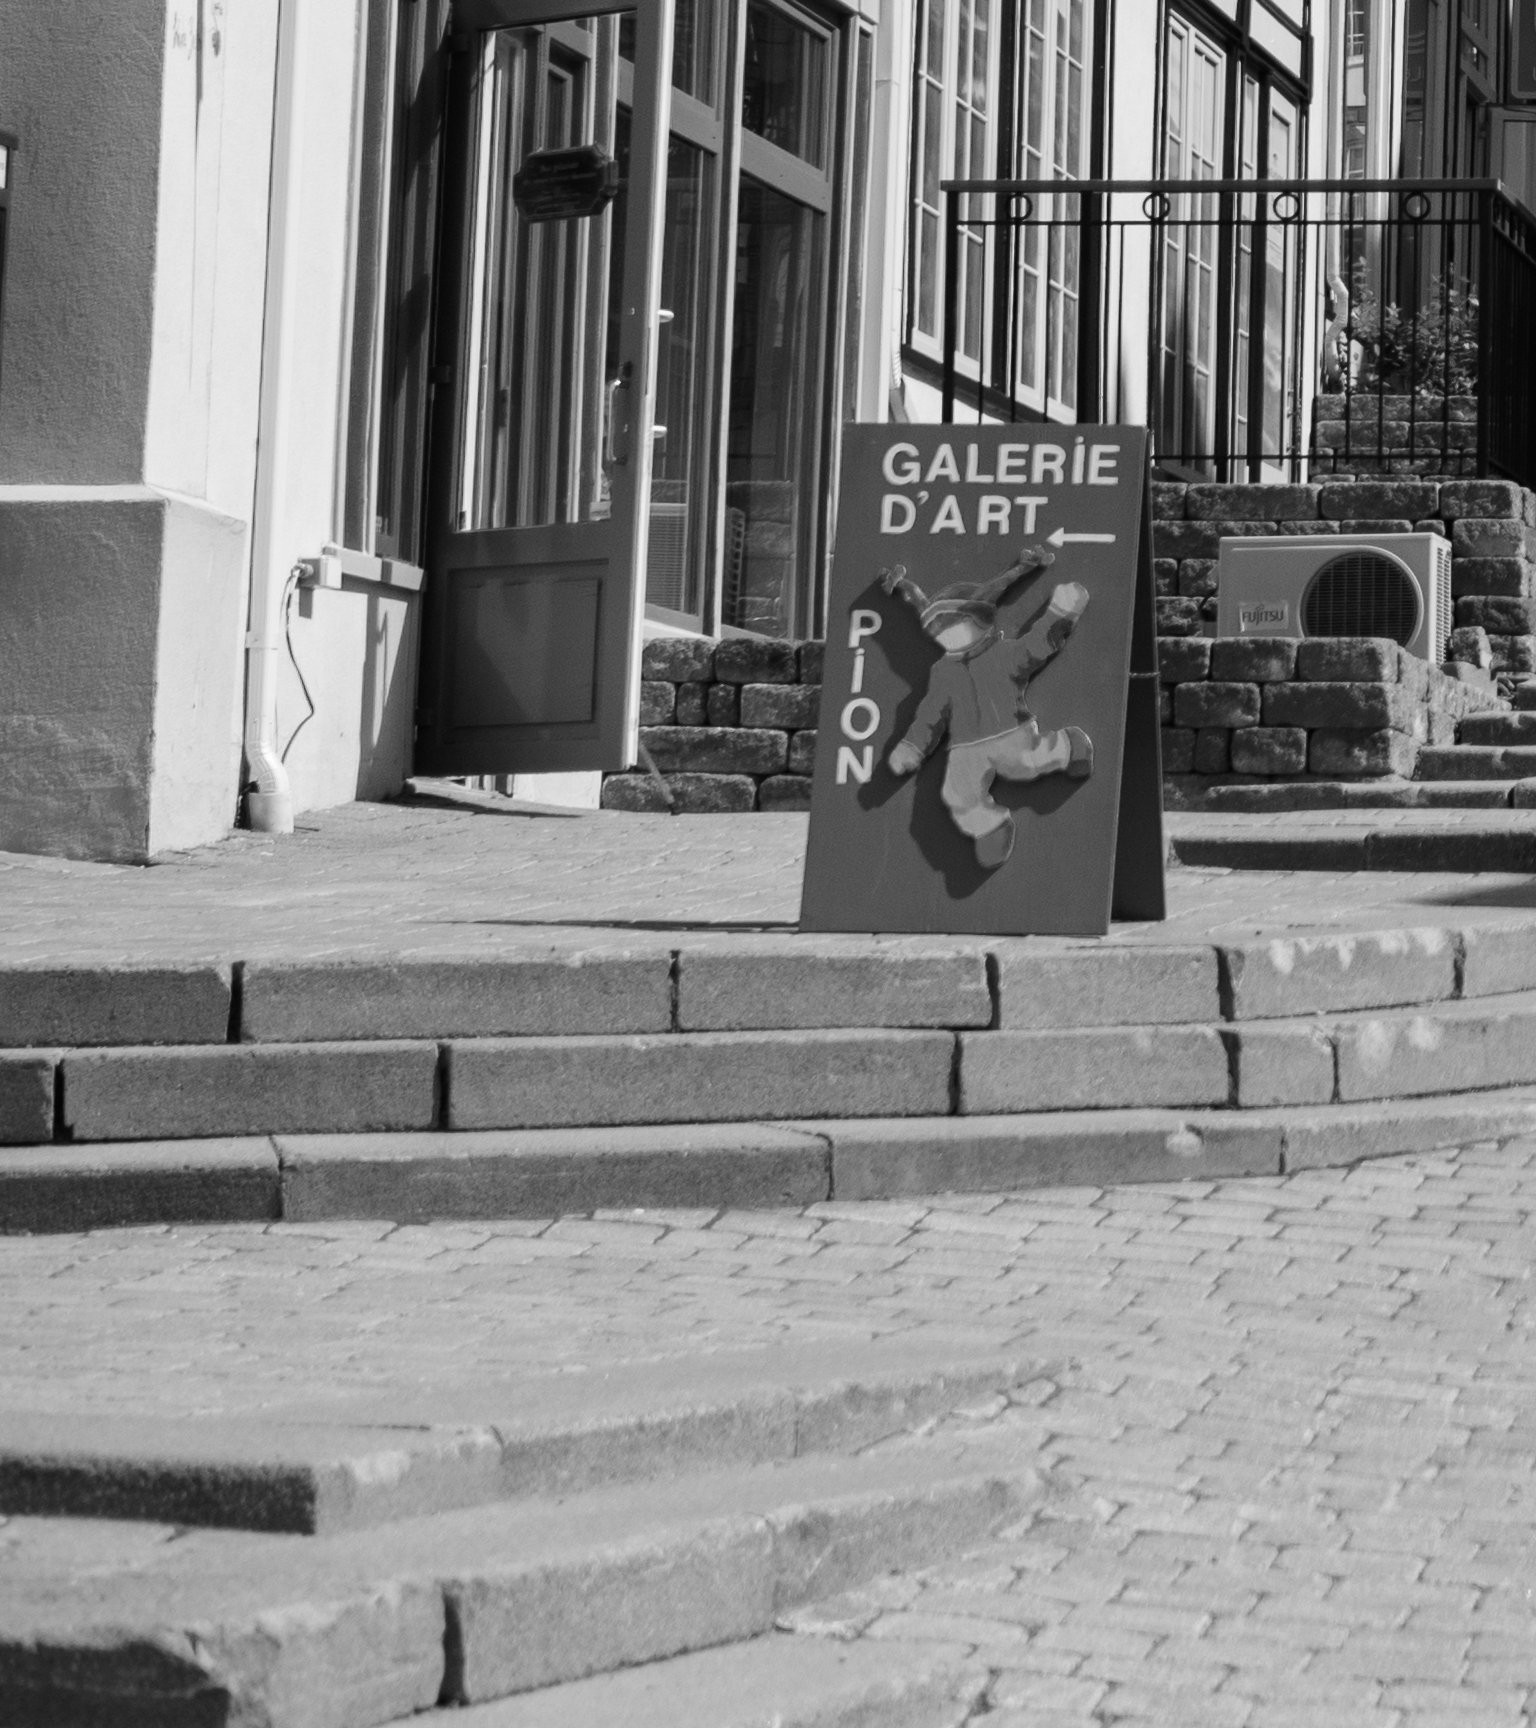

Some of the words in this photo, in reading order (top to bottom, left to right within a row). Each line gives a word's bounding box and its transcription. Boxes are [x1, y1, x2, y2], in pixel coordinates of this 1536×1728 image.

[882, 436, 1120, 486] GALERIE
[880, 490, 1049, 536] D'ART
[1242, 604, 1284, 626] FUJITSU
